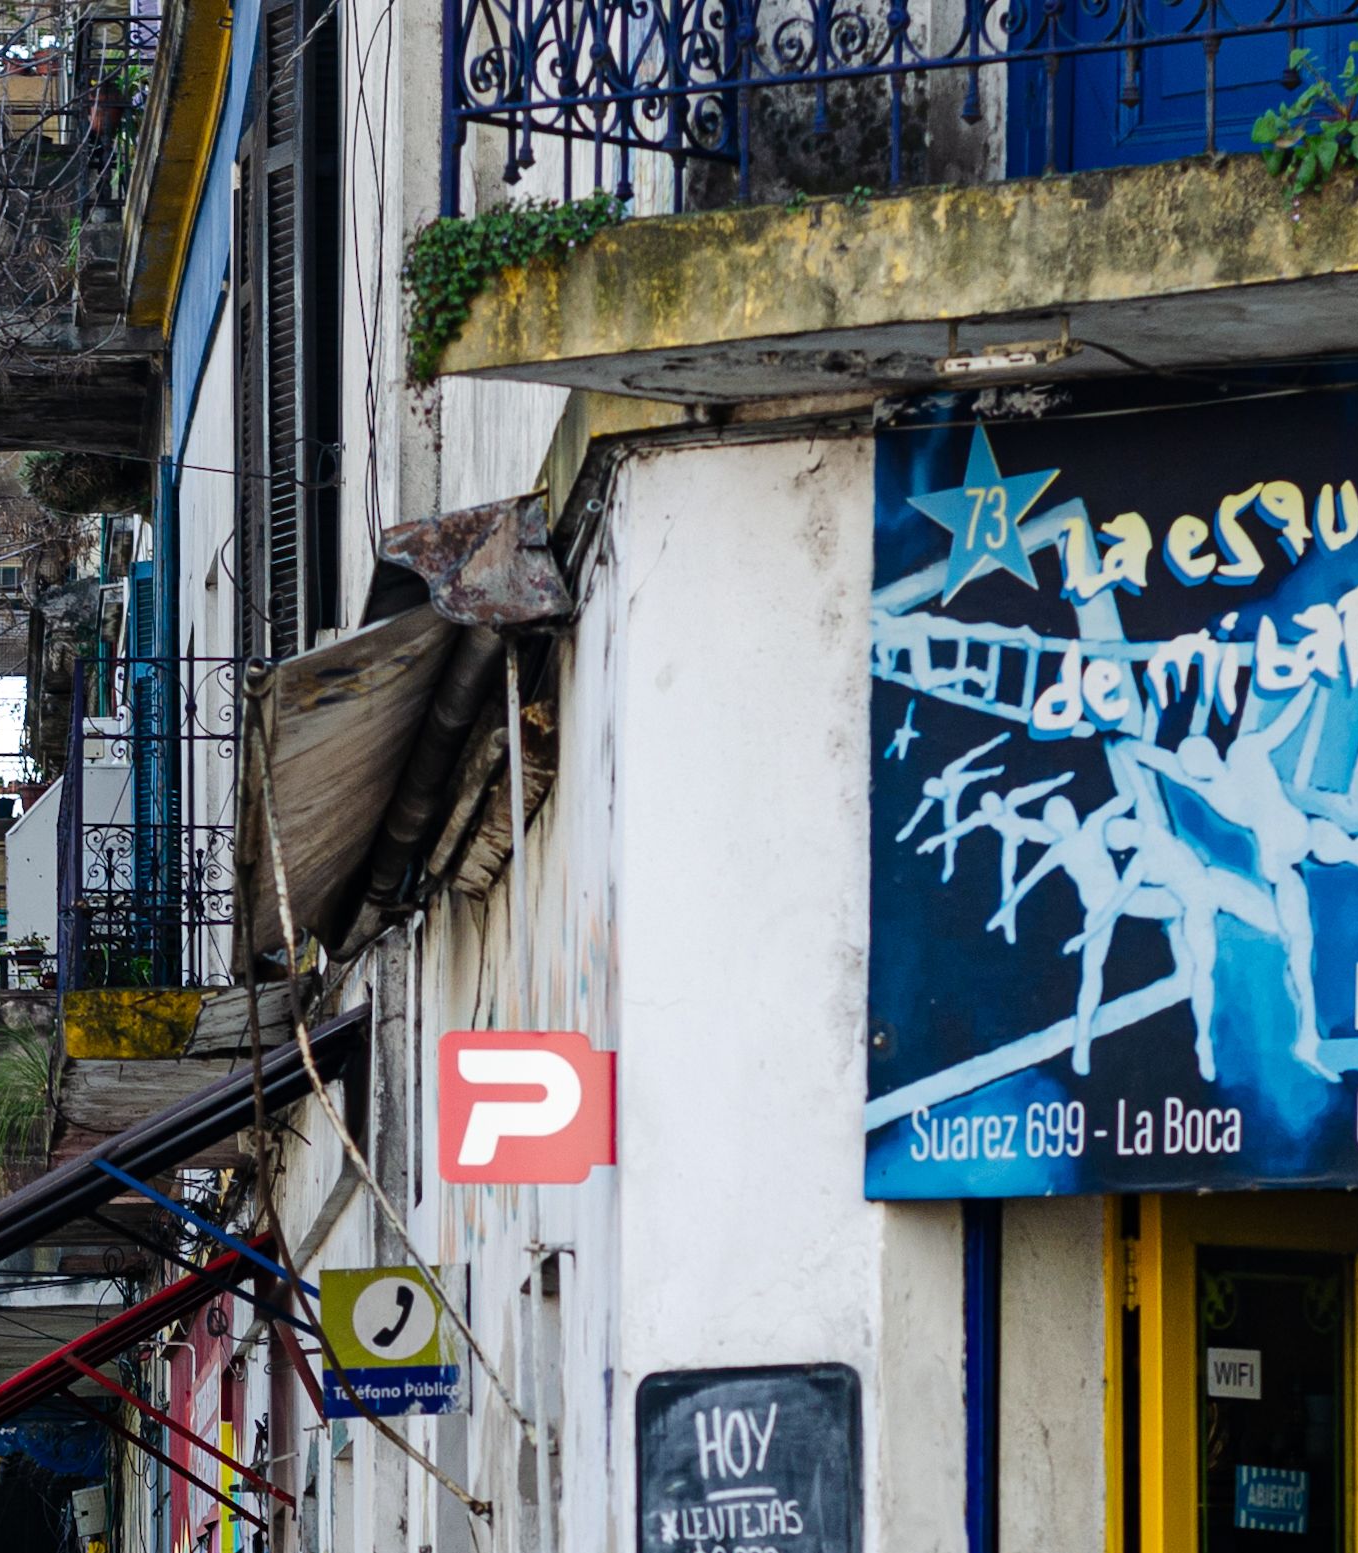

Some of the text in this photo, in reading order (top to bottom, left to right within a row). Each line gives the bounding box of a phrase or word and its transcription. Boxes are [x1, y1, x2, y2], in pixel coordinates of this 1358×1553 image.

[963, 487, 1008, 552] 73
[1060, 512, 1153, 599] La
[1030, 639, 1128, 740] de
[1143, 610, 1239, 726] mi
[909, 1107, 1018, 1162] Suarez
[1025, 1100, 1084, 1158] 699
[1117, 1102, 1156, 1155] La
[1163, 1097, 1241, 1155] Boca
[1214, 1361, 1255, 1388] WIFI
[695, 1402, 777, 1479] HOY
[681, 1500, 803, 1541] LENTEJAS
[1247, 1483, 1304, 1511] ABIERTO
